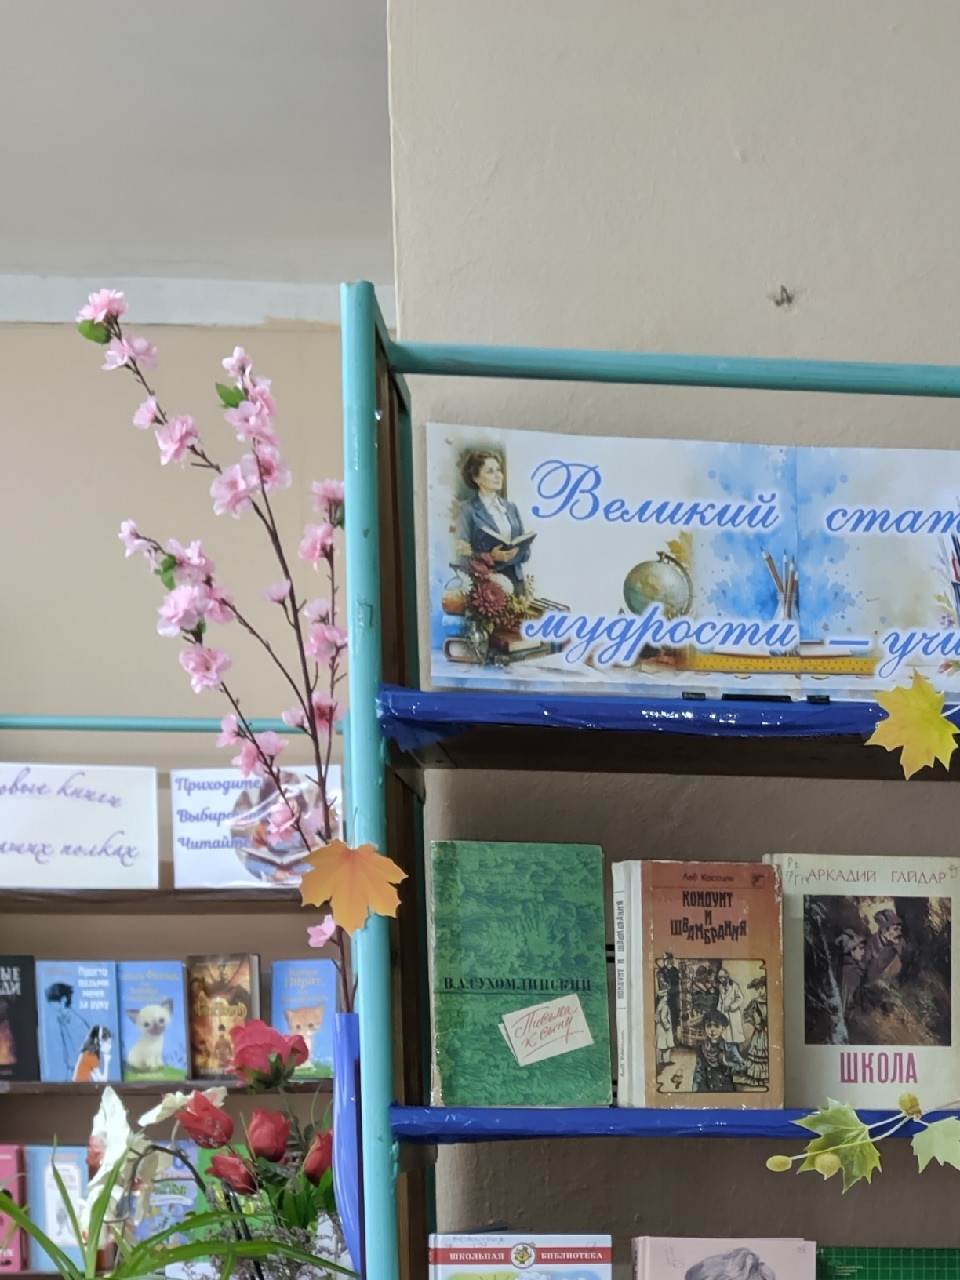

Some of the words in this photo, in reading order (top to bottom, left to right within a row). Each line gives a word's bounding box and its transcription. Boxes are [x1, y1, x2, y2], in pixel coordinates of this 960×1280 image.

[530, 459, 778, 529] Великий
[523, 605, 796, 664] мудрости
[175, 778, 262, 796] Приходите
[808, 869, 876, 884] АРКАДИЙ
[891, 870, 947, 884] ГАЙДАР
[682, 891, 733, 907] КОНДУИТ
[704, 909, 712, 925] И
[671, 917, 747, 944] ШВАМБРАНИЯ
[512, 1004, 578, 1038] Письма
[840, 1052, 918, 1083] ШКОЛА
[450, 1252, 505, 1261] ШКОЛЬНАЯ
